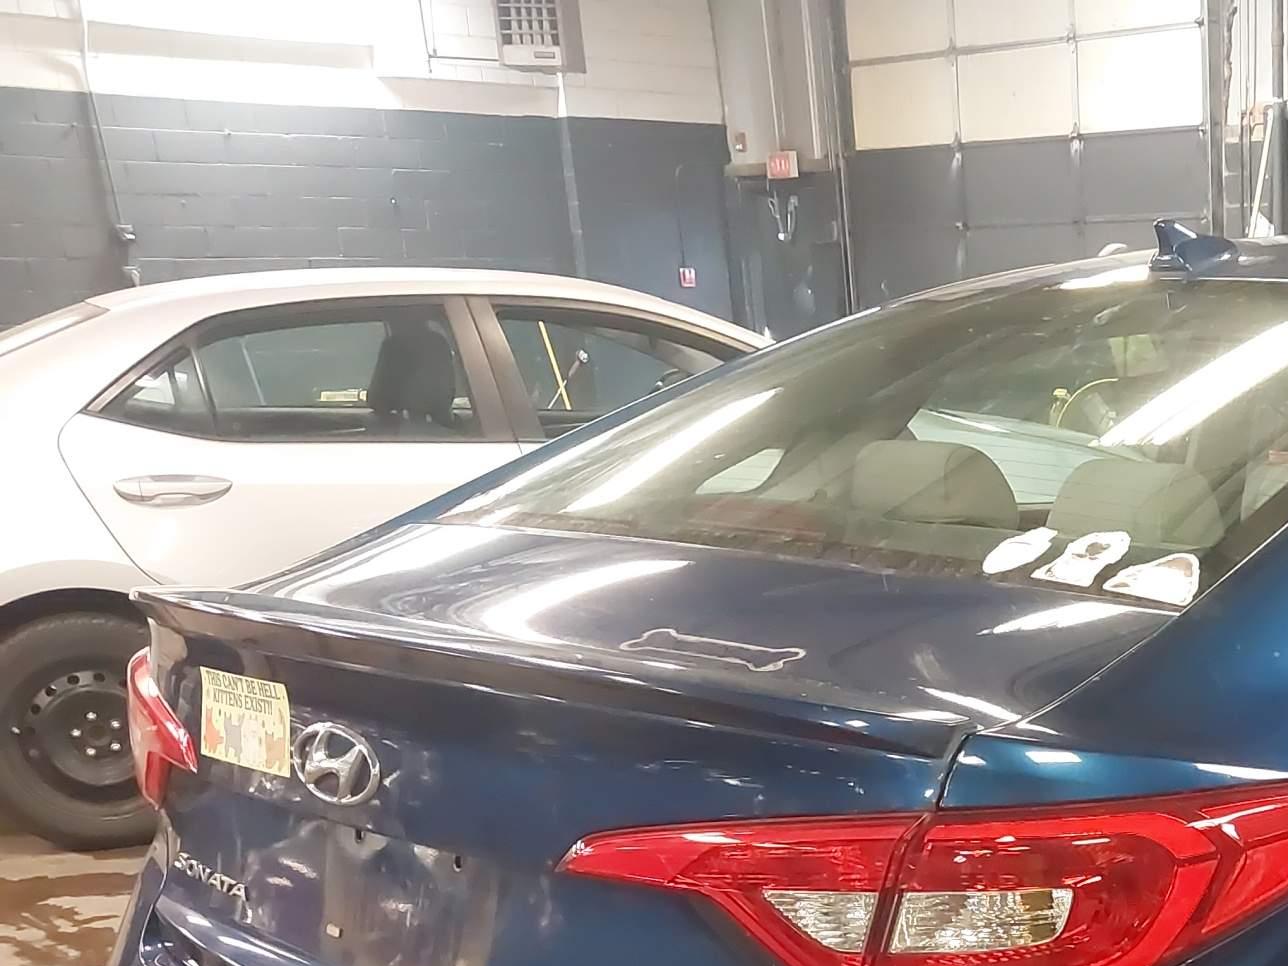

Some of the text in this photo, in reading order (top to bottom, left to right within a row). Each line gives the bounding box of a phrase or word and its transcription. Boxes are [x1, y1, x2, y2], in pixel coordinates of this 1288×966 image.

[206, 670, 281, 700] THIS CAN'T BE HELL
[213, 688, 243, 708] KITTENS
[174, 852, 247, 902] SONATA
